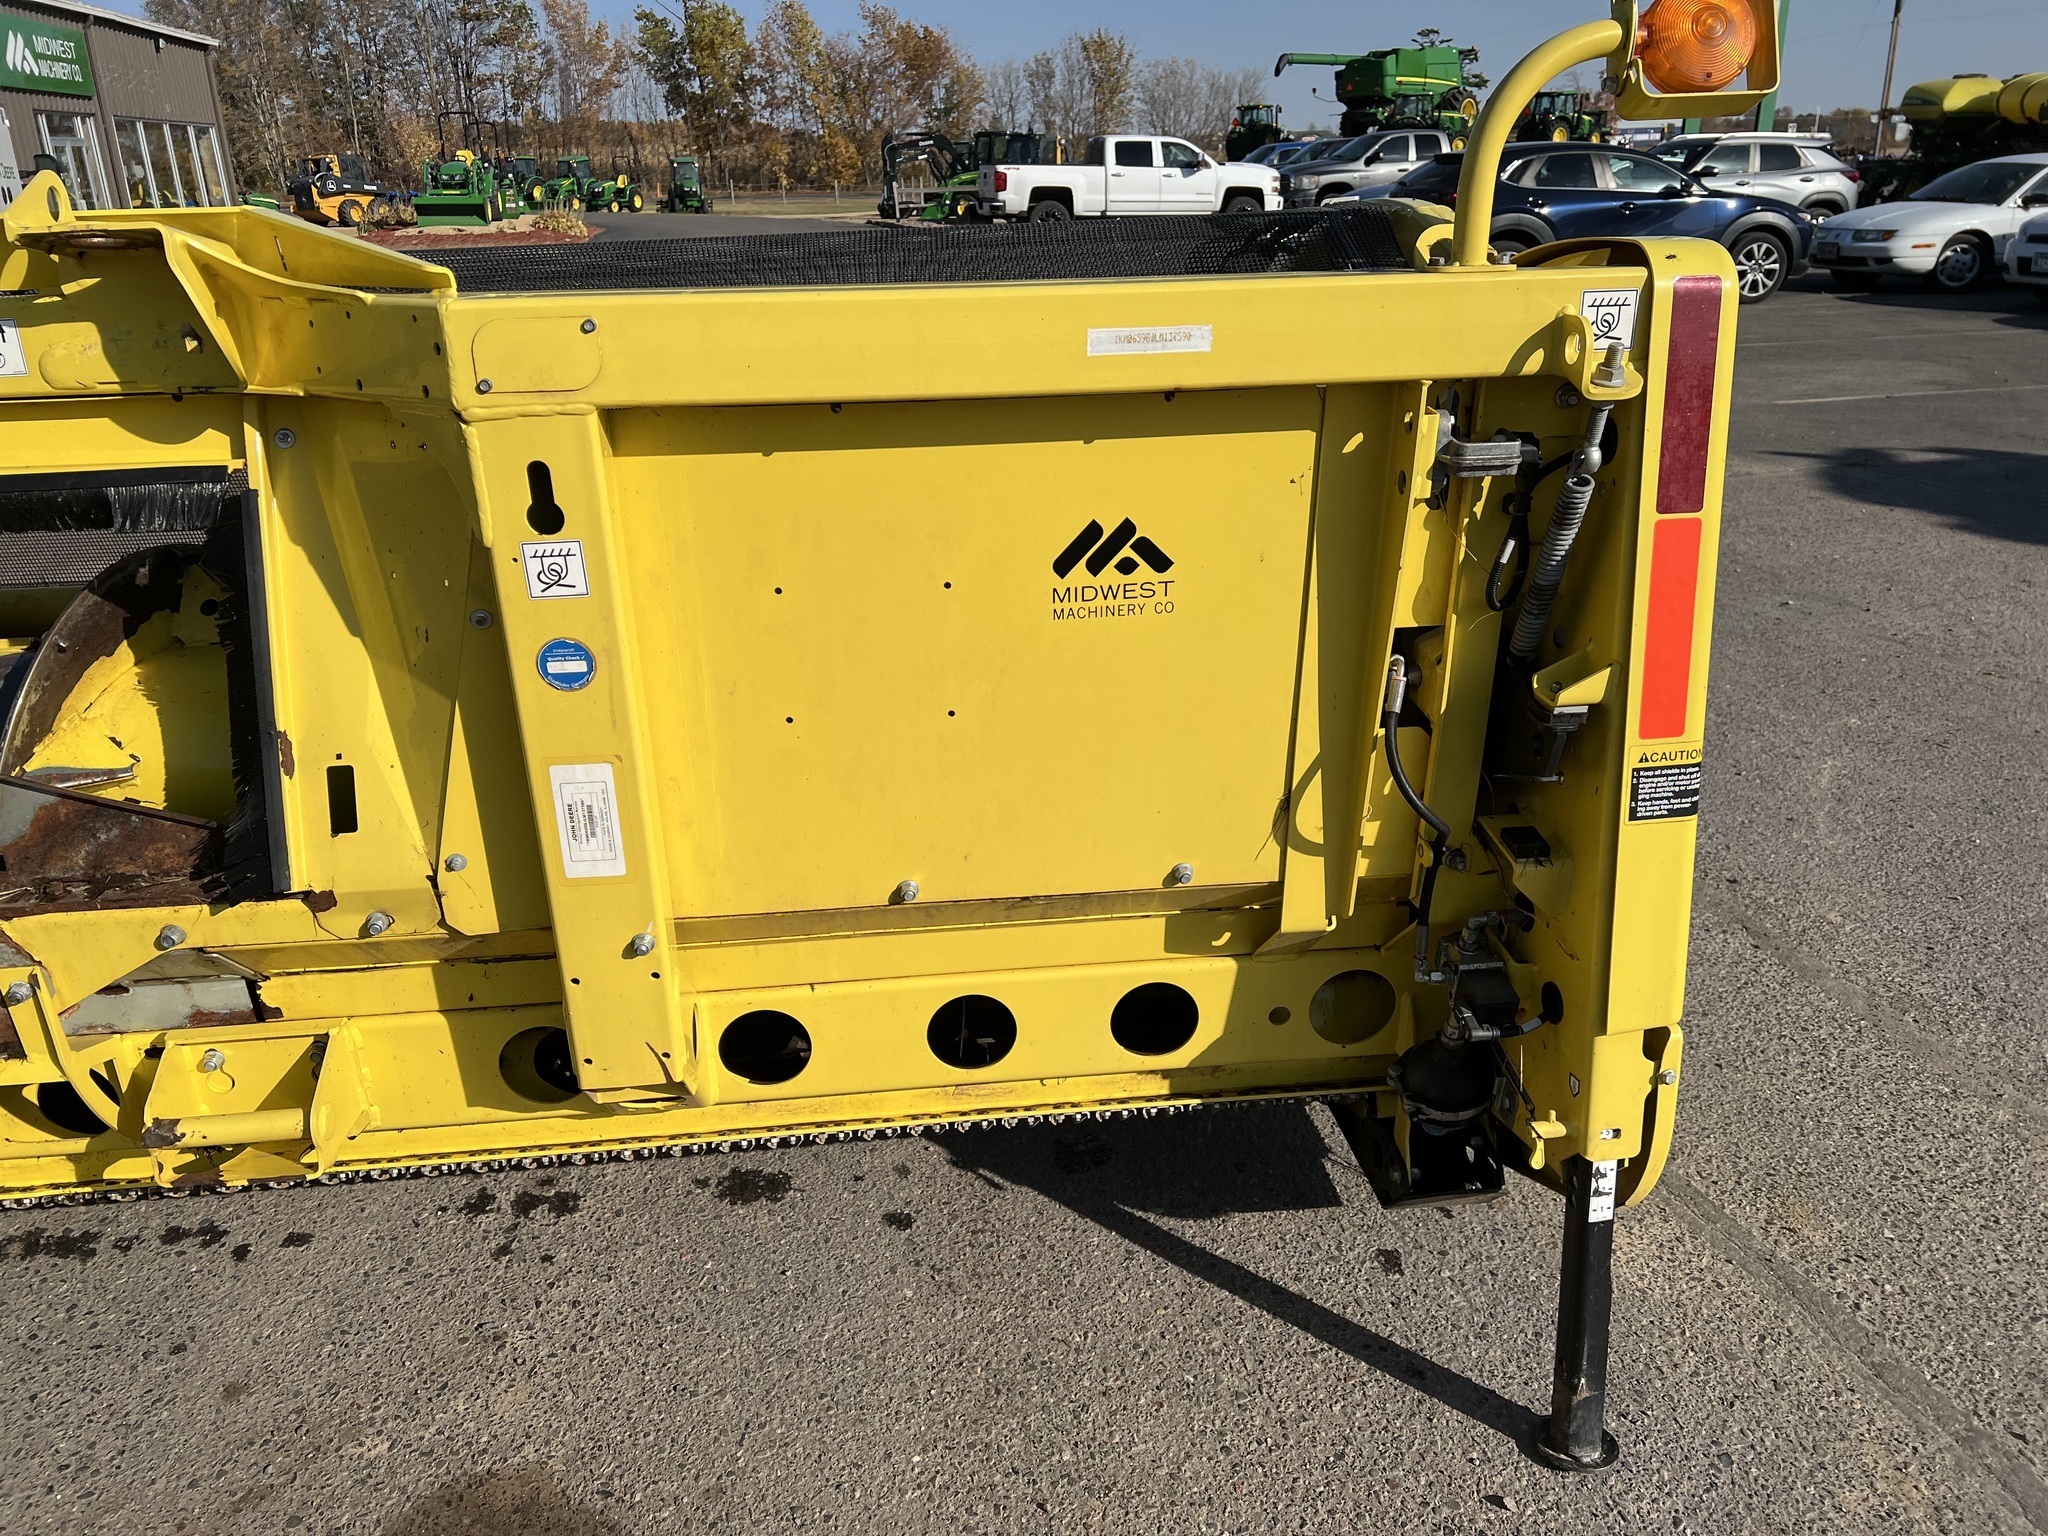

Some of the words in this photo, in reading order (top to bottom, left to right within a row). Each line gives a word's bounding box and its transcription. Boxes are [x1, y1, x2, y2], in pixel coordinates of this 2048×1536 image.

[32, 35, 76, 59] MIDWEST
[38, 59, 73, 80] MACHINERY
[1052, 580, 1175, 604] MIDWEST
[1053, 603, 1146, 621] MACHINERY
[1154, 601, 1174, 615] CO
[566, 803, 575, 824] DEERE
[570, 825, 578, 842] JOHN
